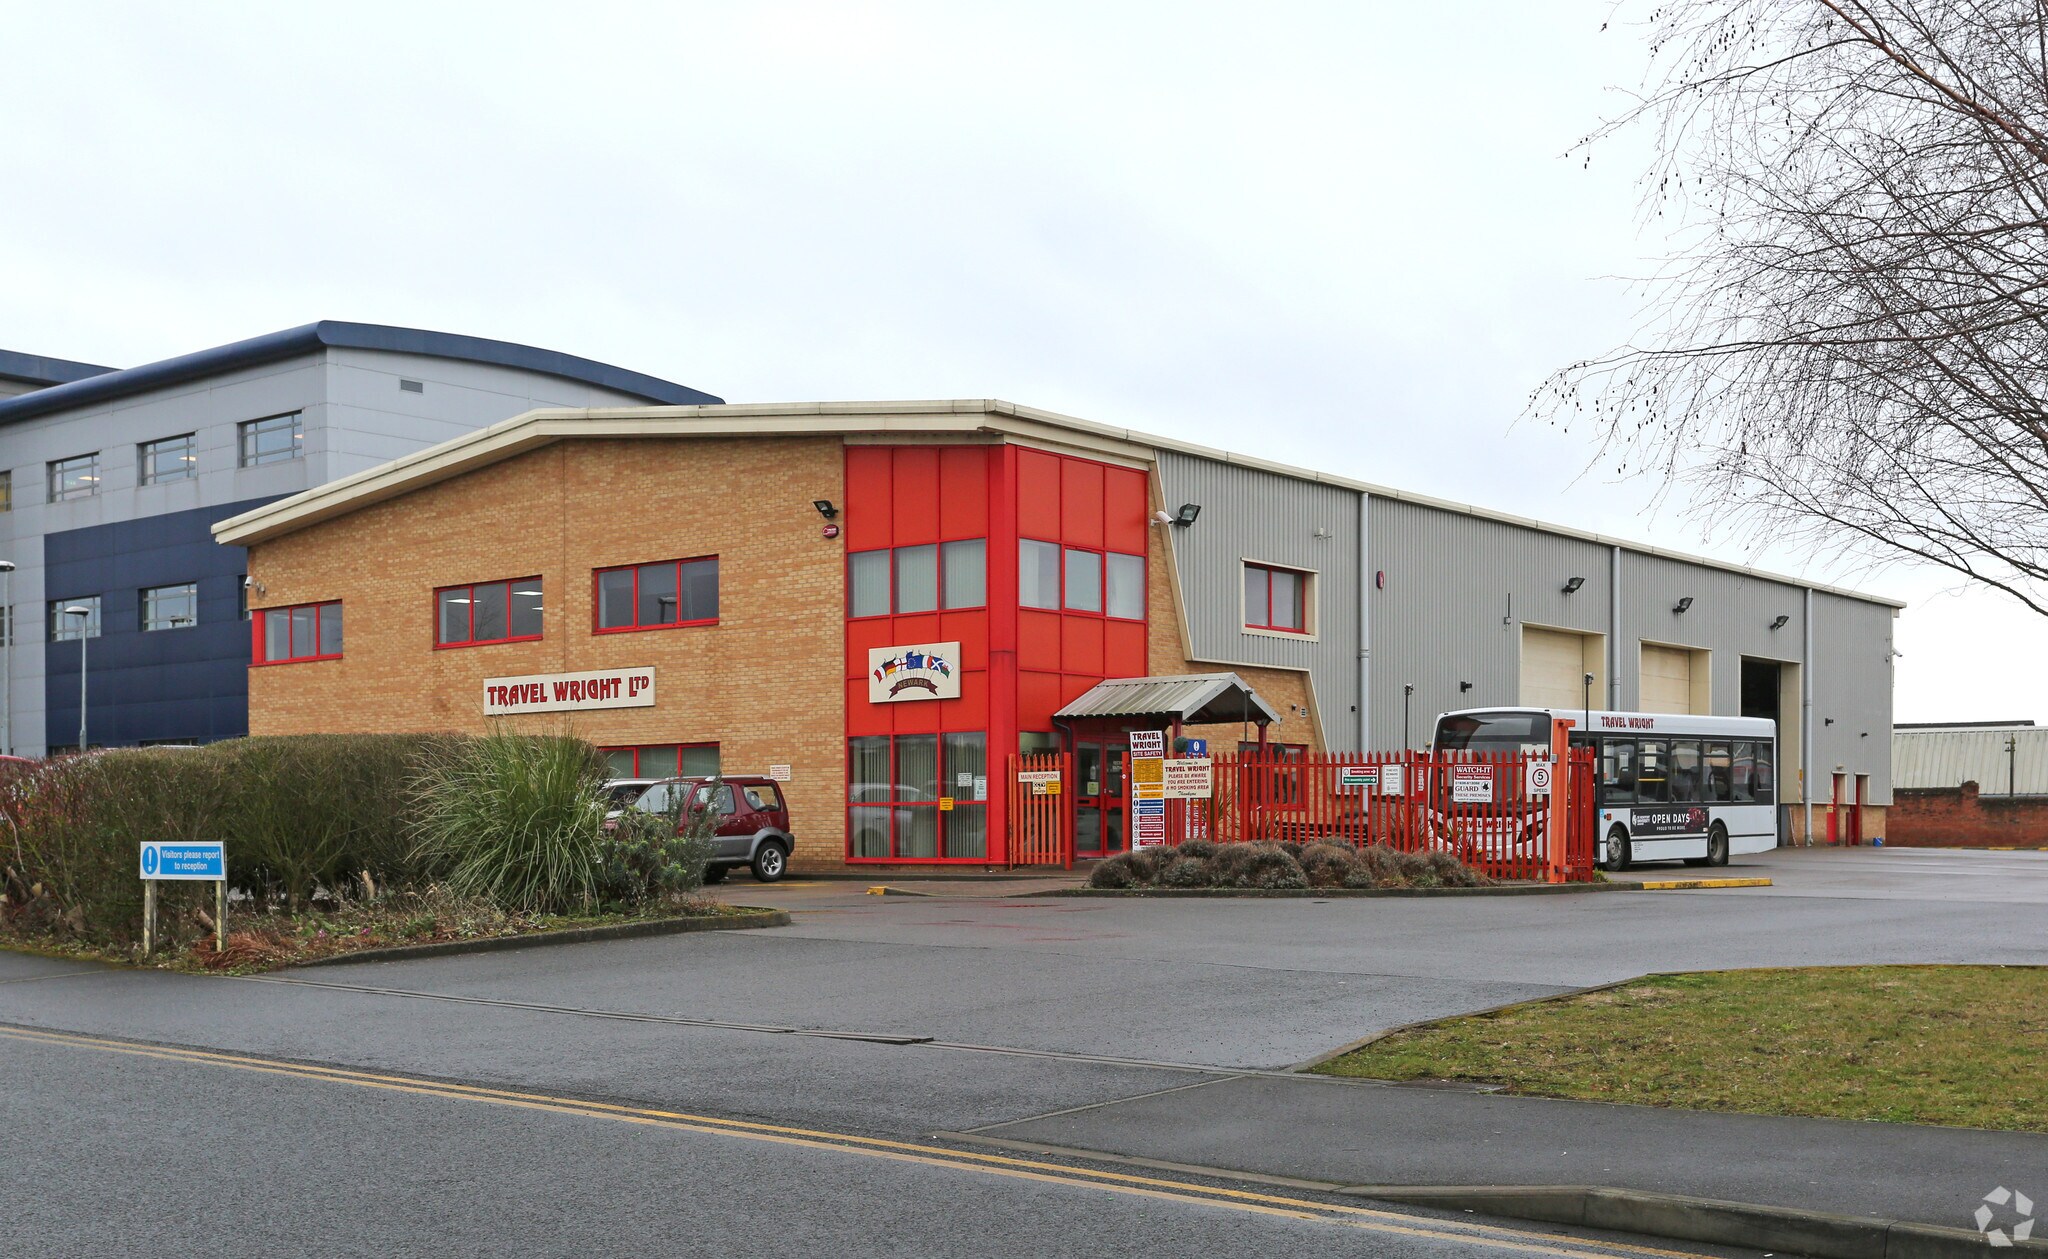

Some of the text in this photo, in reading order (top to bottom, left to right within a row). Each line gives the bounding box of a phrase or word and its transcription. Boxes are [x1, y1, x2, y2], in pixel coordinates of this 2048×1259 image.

[897, 679, 929, 689] NEWARK
[487, 683, 548, 706] TRAVEL
[553, 677, 622, 703] WRIGHT
[1601, 716, 1654, 729] TRAVEL WRIGHT
[1132, 741, 1161, 749] WRIGHT
[1538, 772, 1544, 780] 5
[1652, 813, 1690, 824] OPEN DAYS
[162, 850, 220, 860] Visitors please report
[174, 862, 208, 871] to reception
